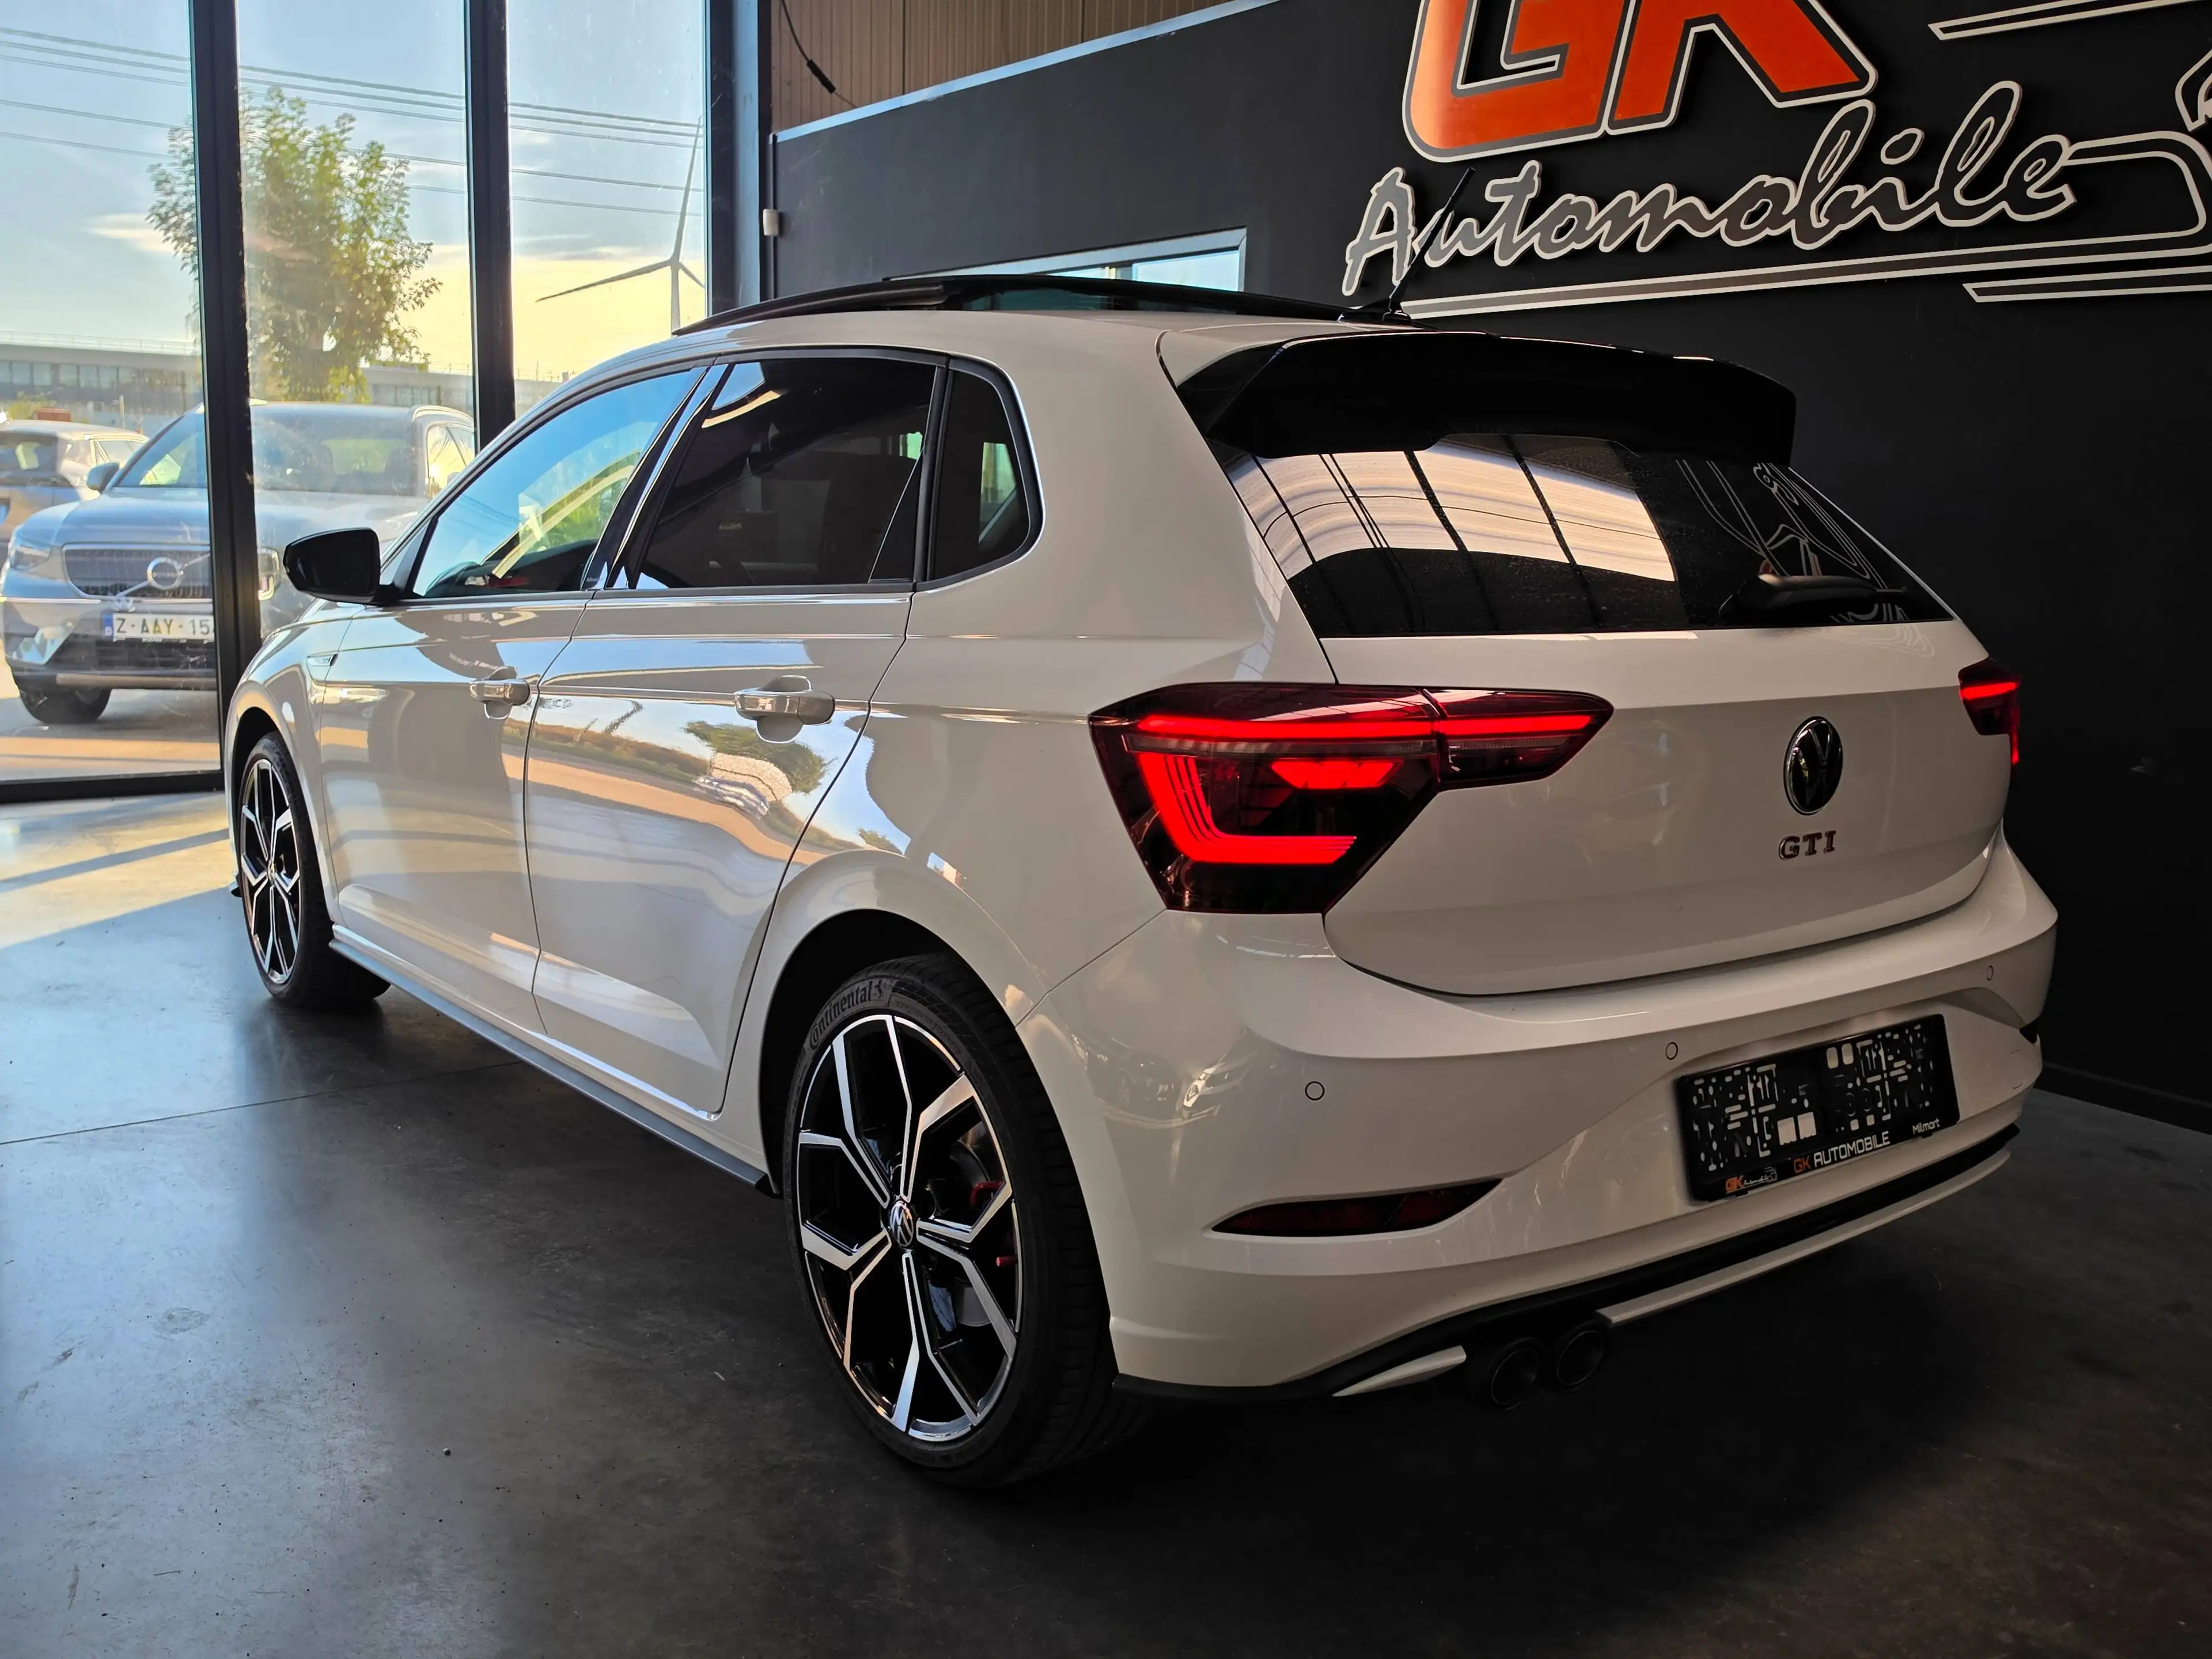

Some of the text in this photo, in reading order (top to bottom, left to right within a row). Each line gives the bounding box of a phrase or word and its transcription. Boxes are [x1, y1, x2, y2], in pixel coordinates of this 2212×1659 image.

[1342, 80, 2077, 297] Automobile
[1778, 830, 1836, 860] GTI
[809, 980, 873, 1050] Continental
[1793, 1130, 1891, 1175] GK AUTOMOBILE
[1725, 1174, 1744, 1193] GK
